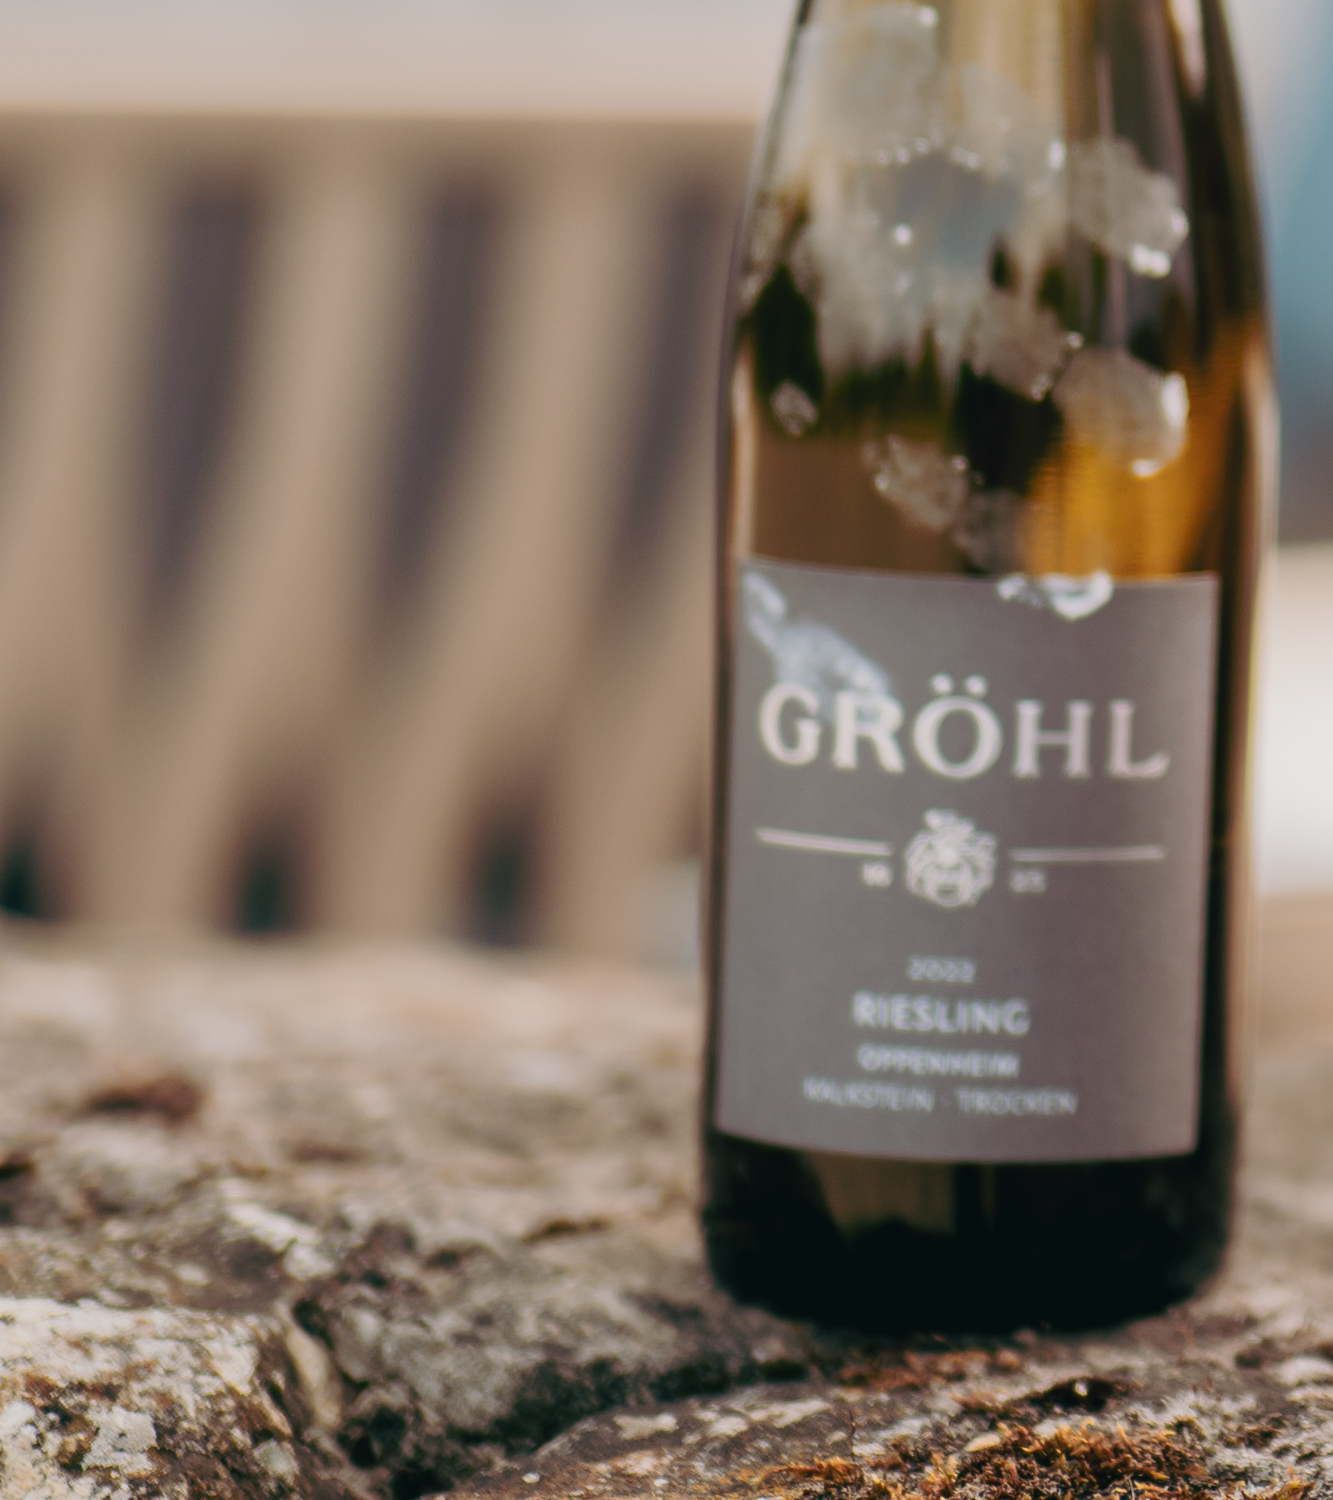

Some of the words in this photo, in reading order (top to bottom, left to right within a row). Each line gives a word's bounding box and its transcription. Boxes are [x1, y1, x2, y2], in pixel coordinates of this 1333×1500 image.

[758, 673, 1171, 780] GRÖHL
[907, 956, 977, 983] 2022
[853, 991, 1031, 1036] RIESLING
[857, 1043, 1020, 1078] OPPENHEIM
[803, 1077, 935, 1113] KALKSTEIN
[956, 1086, 1078, 1116] TROCKEN
